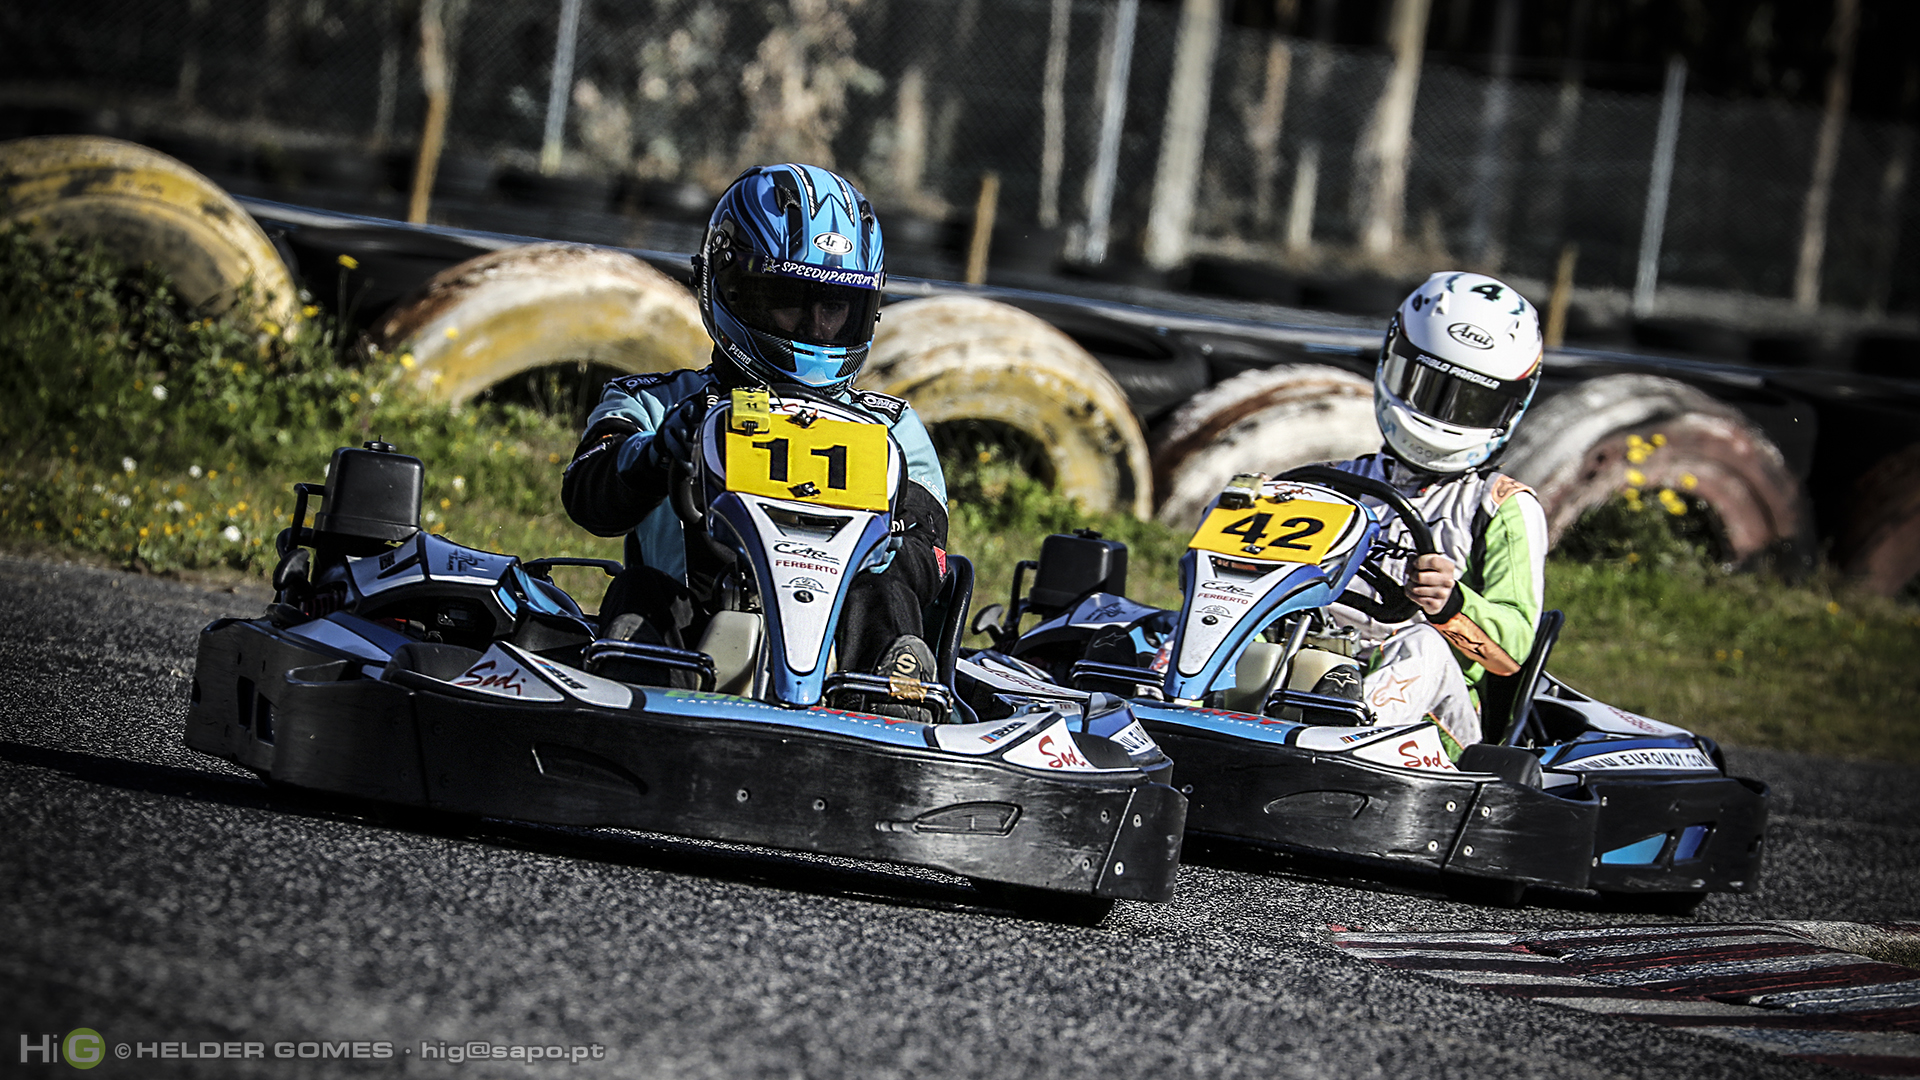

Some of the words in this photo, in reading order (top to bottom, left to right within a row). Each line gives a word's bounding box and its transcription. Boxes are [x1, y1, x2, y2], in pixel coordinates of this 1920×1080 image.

[816, 235, 849, 250] Ari
[1470, 283, 1504, 302] 4
[1450, 324, 1491, 346] Arai
[728, 342, 752, 365] PEDRO
[1415, 353, 1452, 373] PABLO
[1448, 366, 1501, 391] PARDILLA
[745, 402, 758, 410] 11
[863, 396, 900, 411] OMP
[752, 437, 848, 490] 11
[1220, 512, 1324, 551] 42
[774, 559, 839, 576] FERBERTO
[1197, 592, 1249, 605] FERBERTO
[455, 659, 527, 696] Sodi
